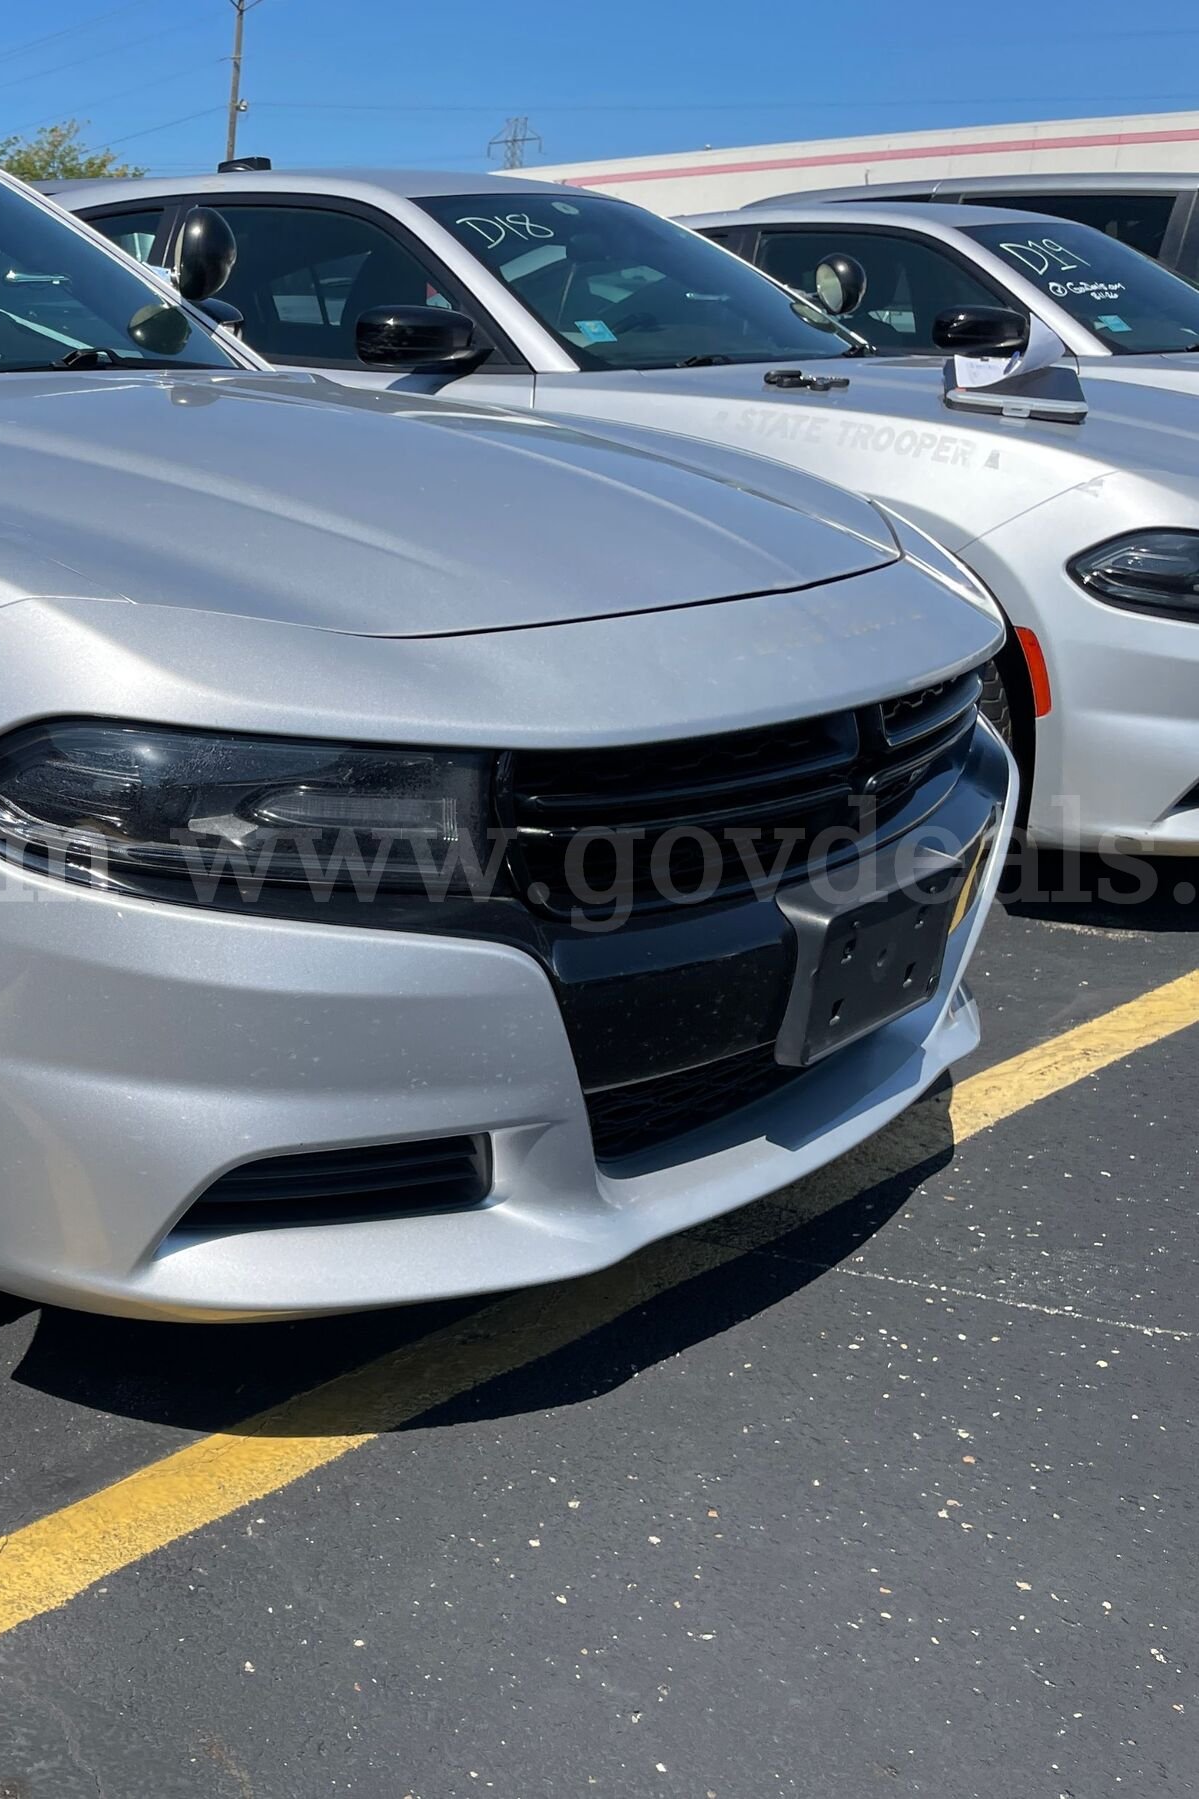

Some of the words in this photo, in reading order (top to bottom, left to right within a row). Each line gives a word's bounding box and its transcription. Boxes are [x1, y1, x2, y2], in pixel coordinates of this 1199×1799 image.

[455, 212, 555, 250] D18
[999, 238, 1092, 276] D19
[735, 407, 830, 445] STATE
[834, 420, 978, 468] TROOPER
